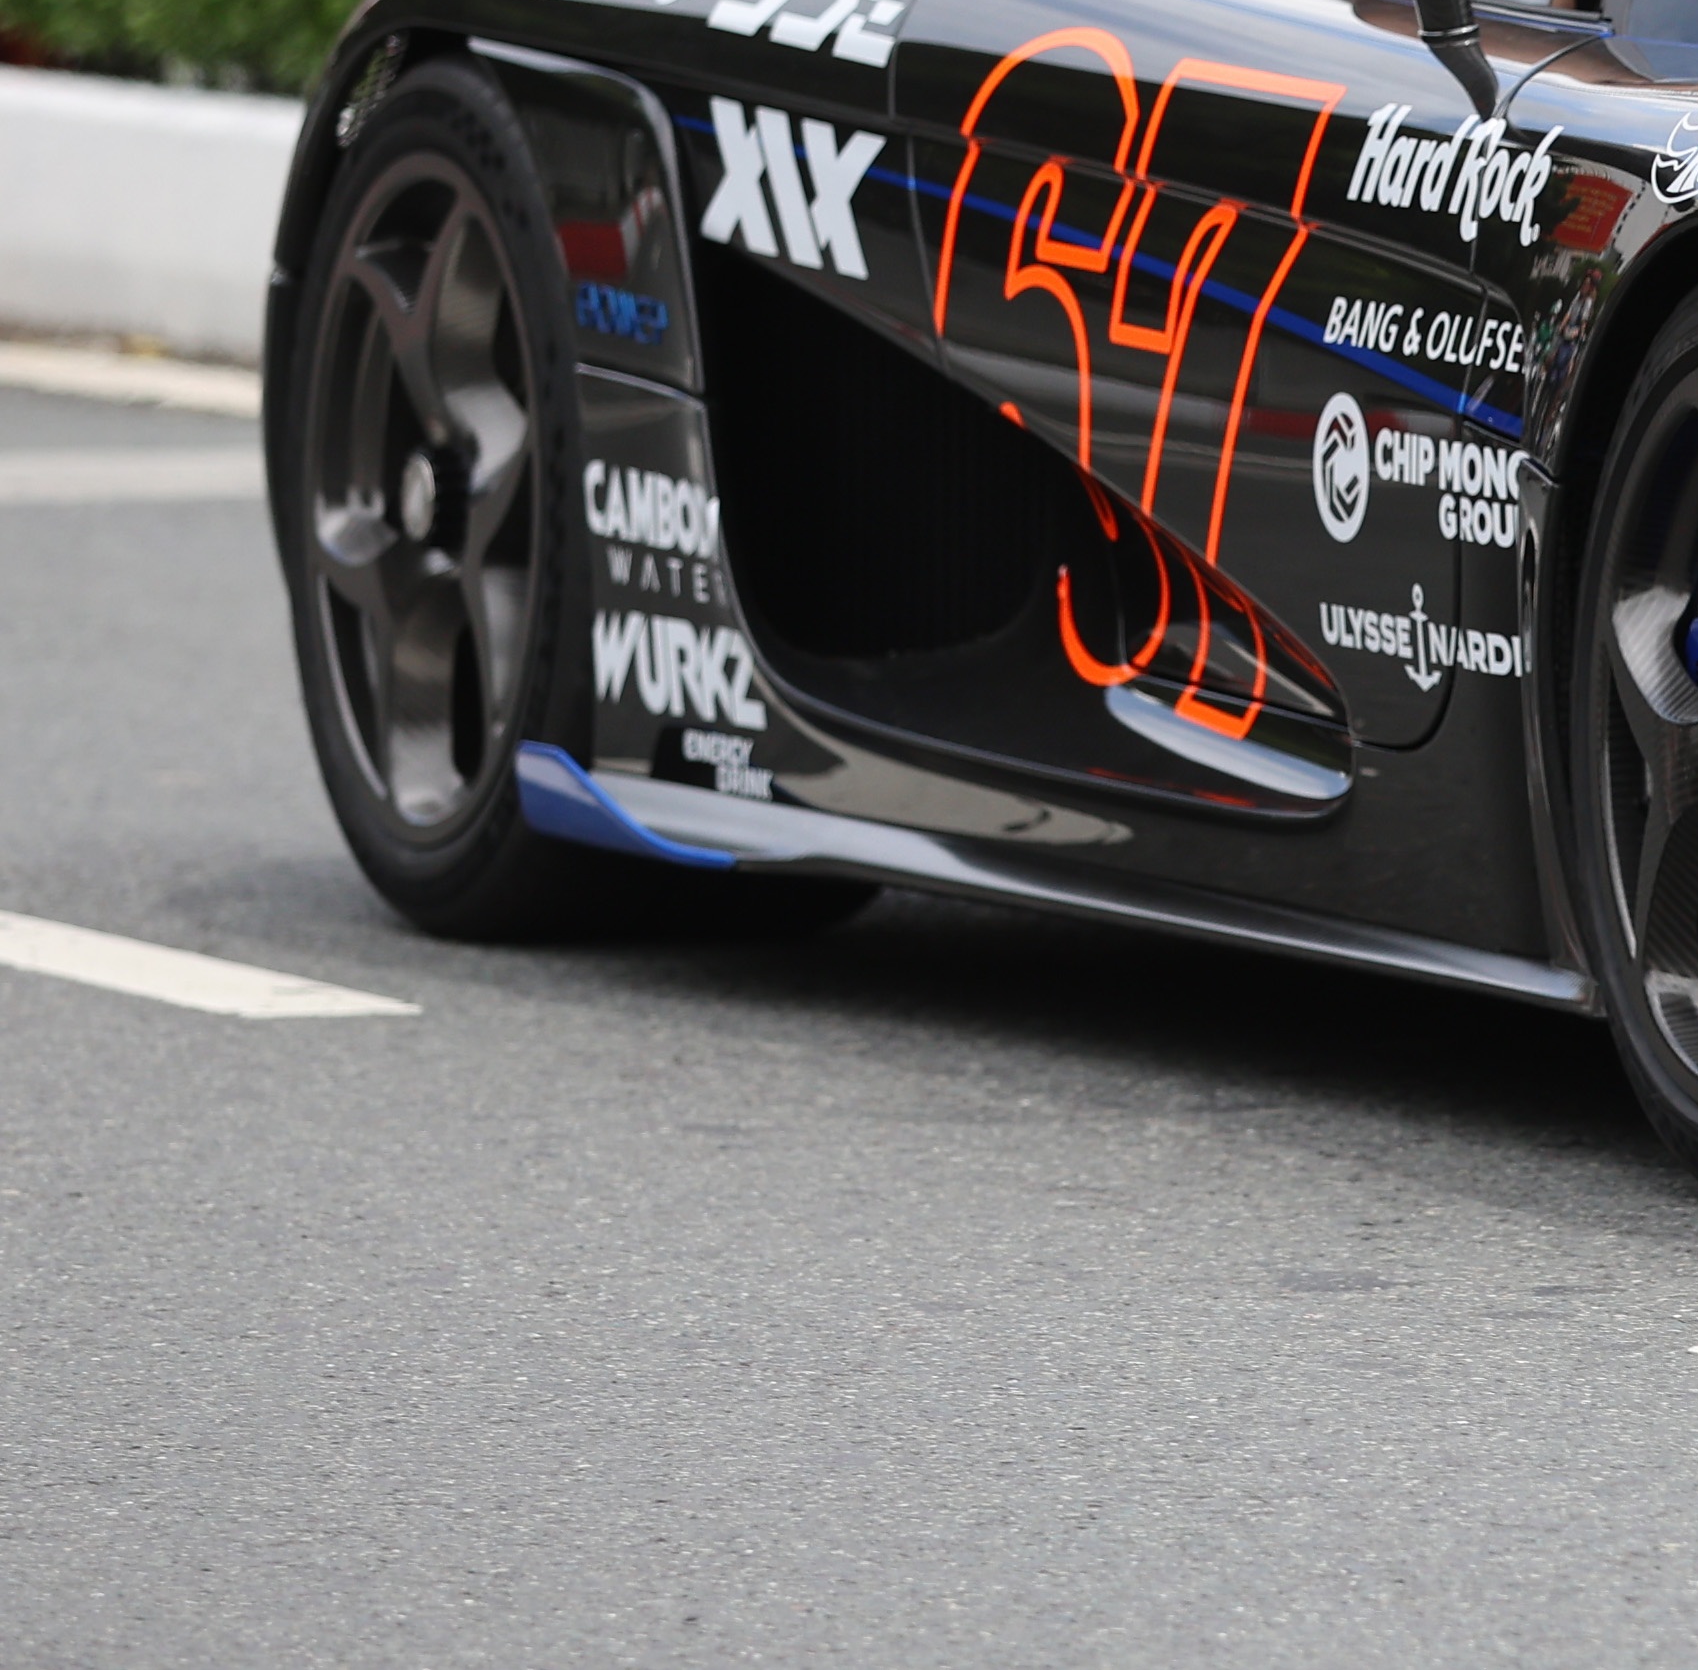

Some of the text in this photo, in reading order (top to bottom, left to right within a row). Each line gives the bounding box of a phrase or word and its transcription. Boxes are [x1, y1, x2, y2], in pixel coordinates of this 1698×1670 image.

[700, 95, 886, 280] XIX
[1346, 102, 1565, 247] Hard Rock
[1322, 295, 1526, 375] BANG & OLUFSE
[1374, 426, 1436, 487] CHIP
[1437, 492, 1520, 549] GROU
[1319, 600, 1414, 660] ULYSSE
